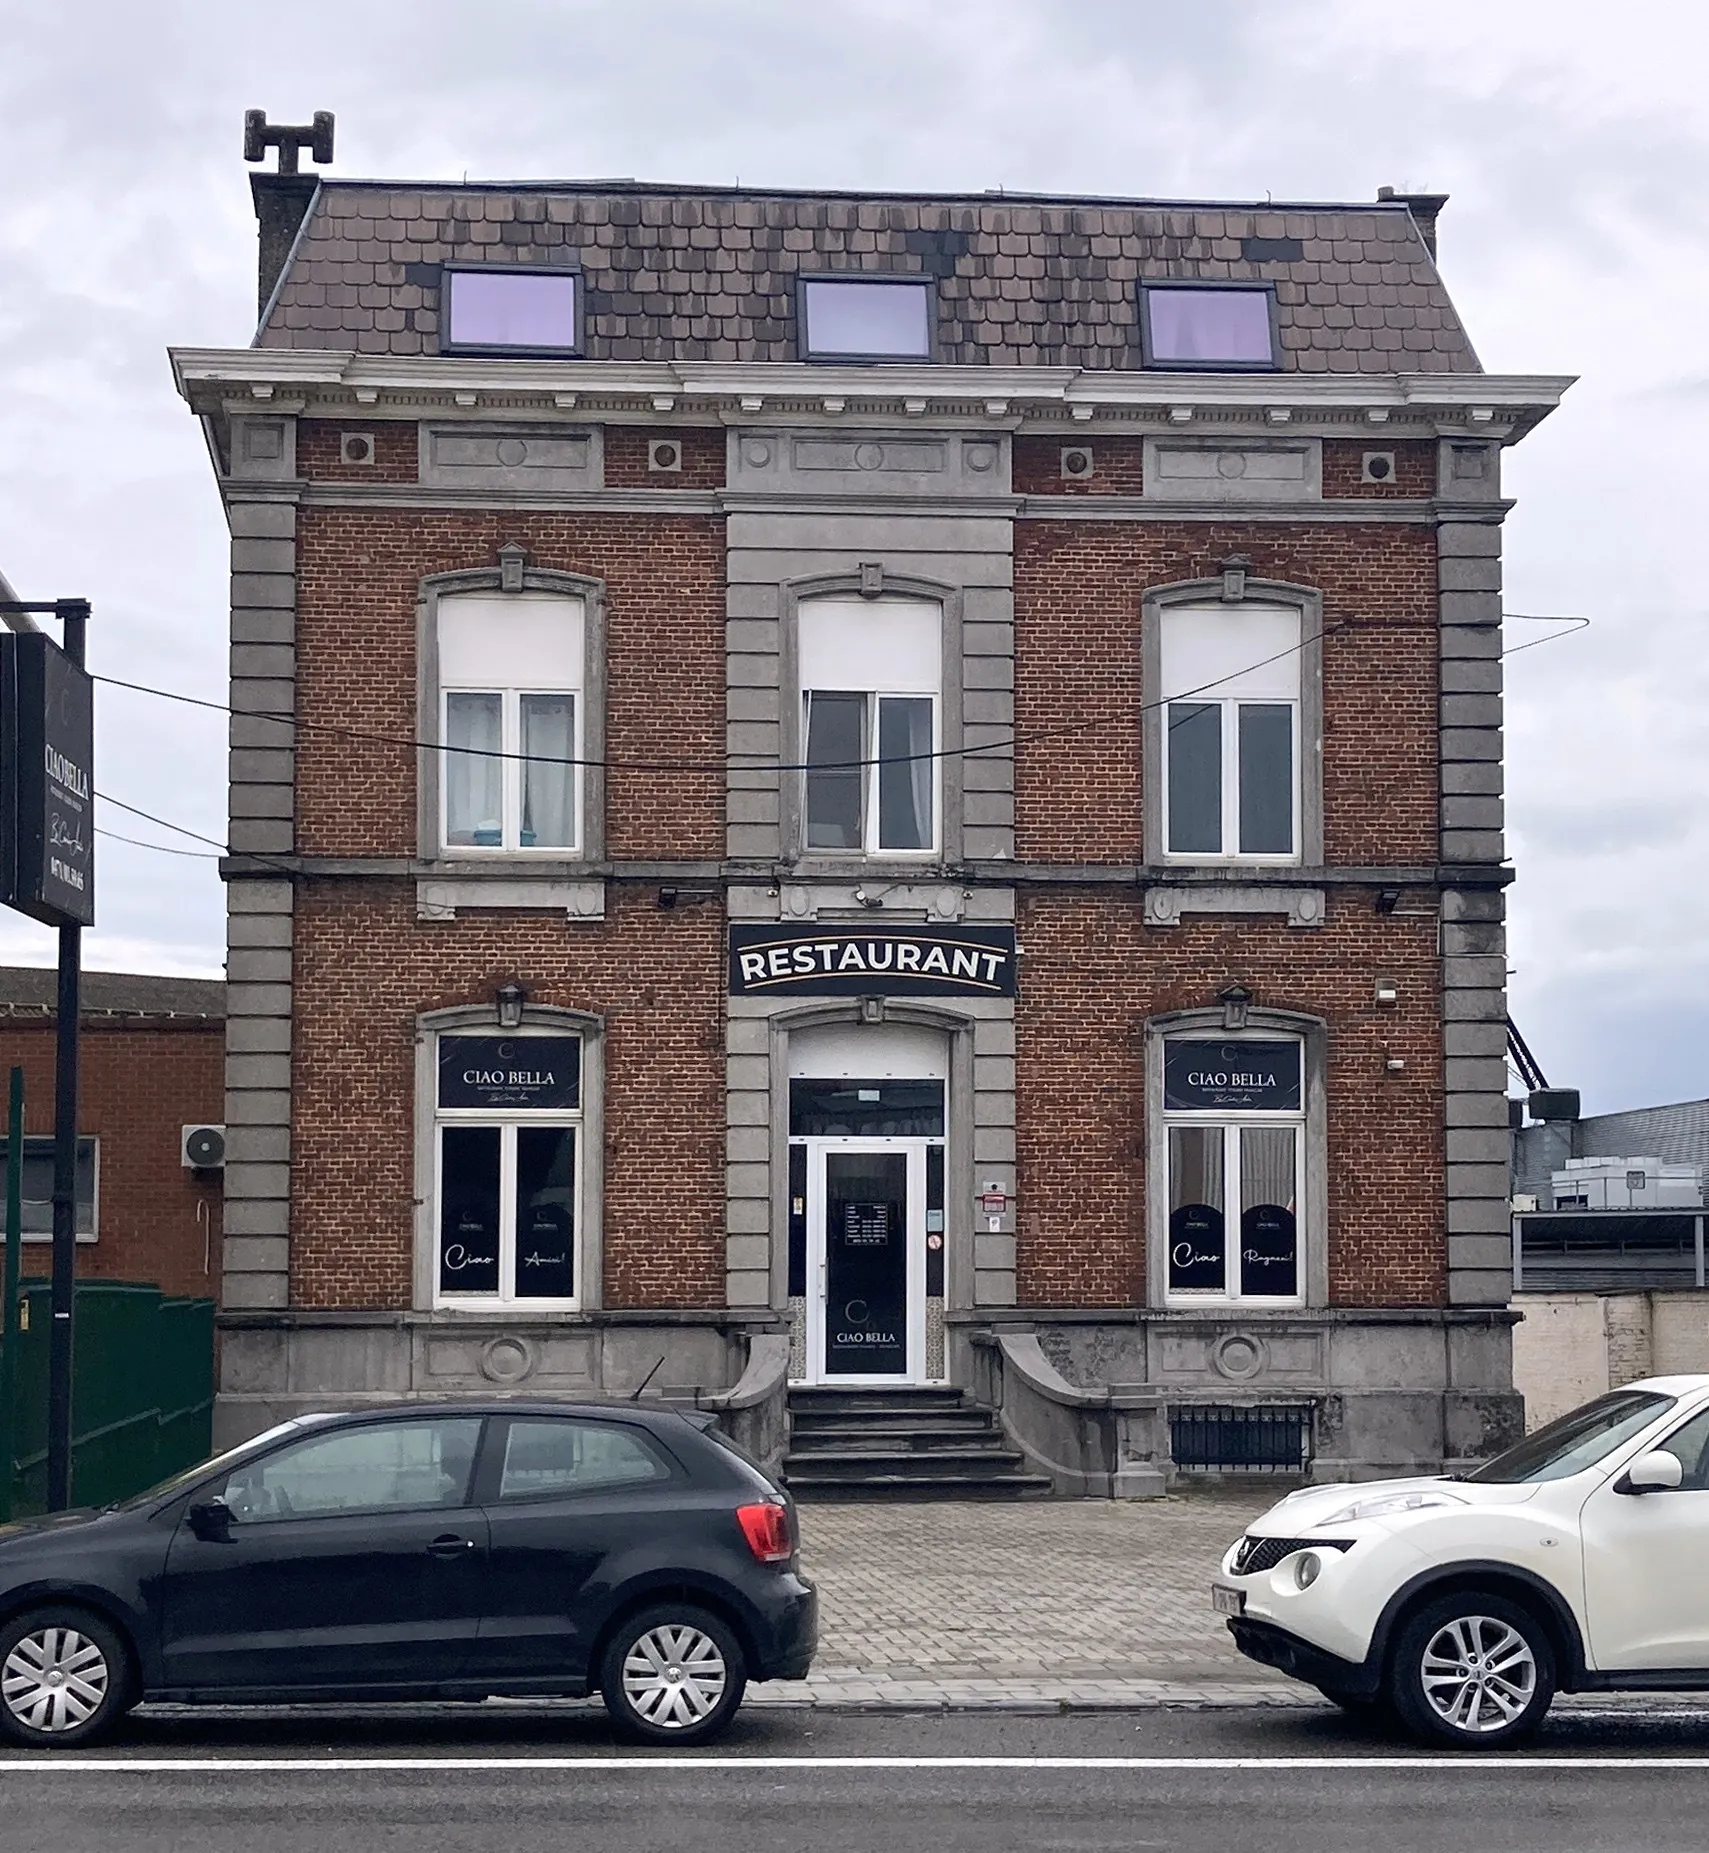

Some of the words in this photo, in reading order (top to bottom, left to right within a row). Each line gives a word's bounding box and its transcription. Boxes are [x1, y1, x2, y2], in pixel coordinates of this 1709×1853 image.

[740, 943, 1006, 981] RESTAURANT
[463, 1070, 504, 1085] CIAO
[509, 1071, 555, 1085] BELLA
[1188, 1072, 1228, 1086] CIAO
[1232, 1073, 1277, 1087] BELLA
[445, 1244, 495, 1270] Ciao
[1173, 1242, 1221, 1268] Ciao
[836, 1332, 864, 1343] CIAO
[866, 1332, 896, 1343] BELLA
